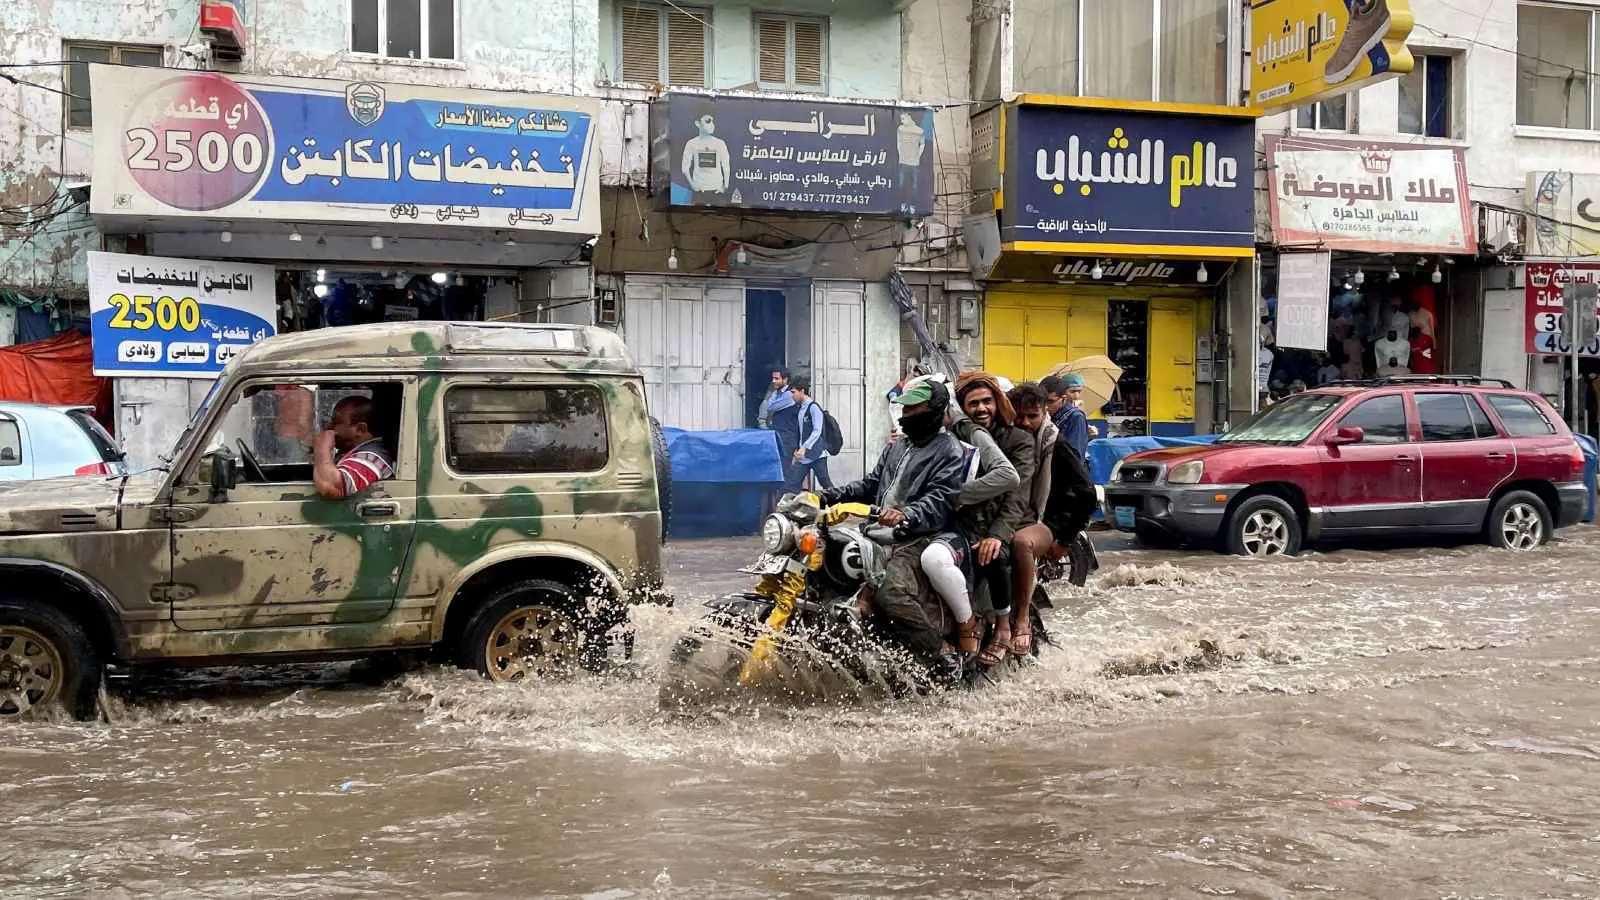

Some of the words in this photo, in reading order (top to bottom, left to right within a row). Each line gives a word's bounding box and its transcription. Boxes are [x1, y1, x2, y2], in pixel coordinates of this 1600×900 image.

[1256, 18, 1305, 72] الشباب
[1308, 12, 1336, 63] عالم
[126, 126, 264, 173] 2500
[742, 144, 794, 164] الجاهزة
[797, 149, 851, 166] للملابس
[280, 137, 403, 187] الكابتن
[408, 144, 576, 196] تخفيضات
[1036, 127, 1165, 196] الشباب
[801, 169, 829, 187] ولادي
[835, 171, 860, 187] شبابي
[867, 174, 892, 189] رجالي
[1170, 141, 1238, 208] عالم
[1282, 172, 1394, 206] الموضة
[1405, 178, 1456, 204] ملك
[436, 205, 480, 221] شبابي
[1332, 207, 1374, 221] الجاهزة
[1377, 210, 1419, 223] للملابس
[1036, 218, 1069, 233] الراقية
[1071, 218, 1108, 234] للأحذية
[116, 265, 199, 290] للتخفيضات
[1126, 262, 1176, 282] عالم
[203, 271, 253, 294] الكابتن
[107, 293, 200, 332] 2500
[223, 325, 250, 340] قطعة
[125, 343, 156, 362] ولادي
[171, 344, 206, 361] شبابي
